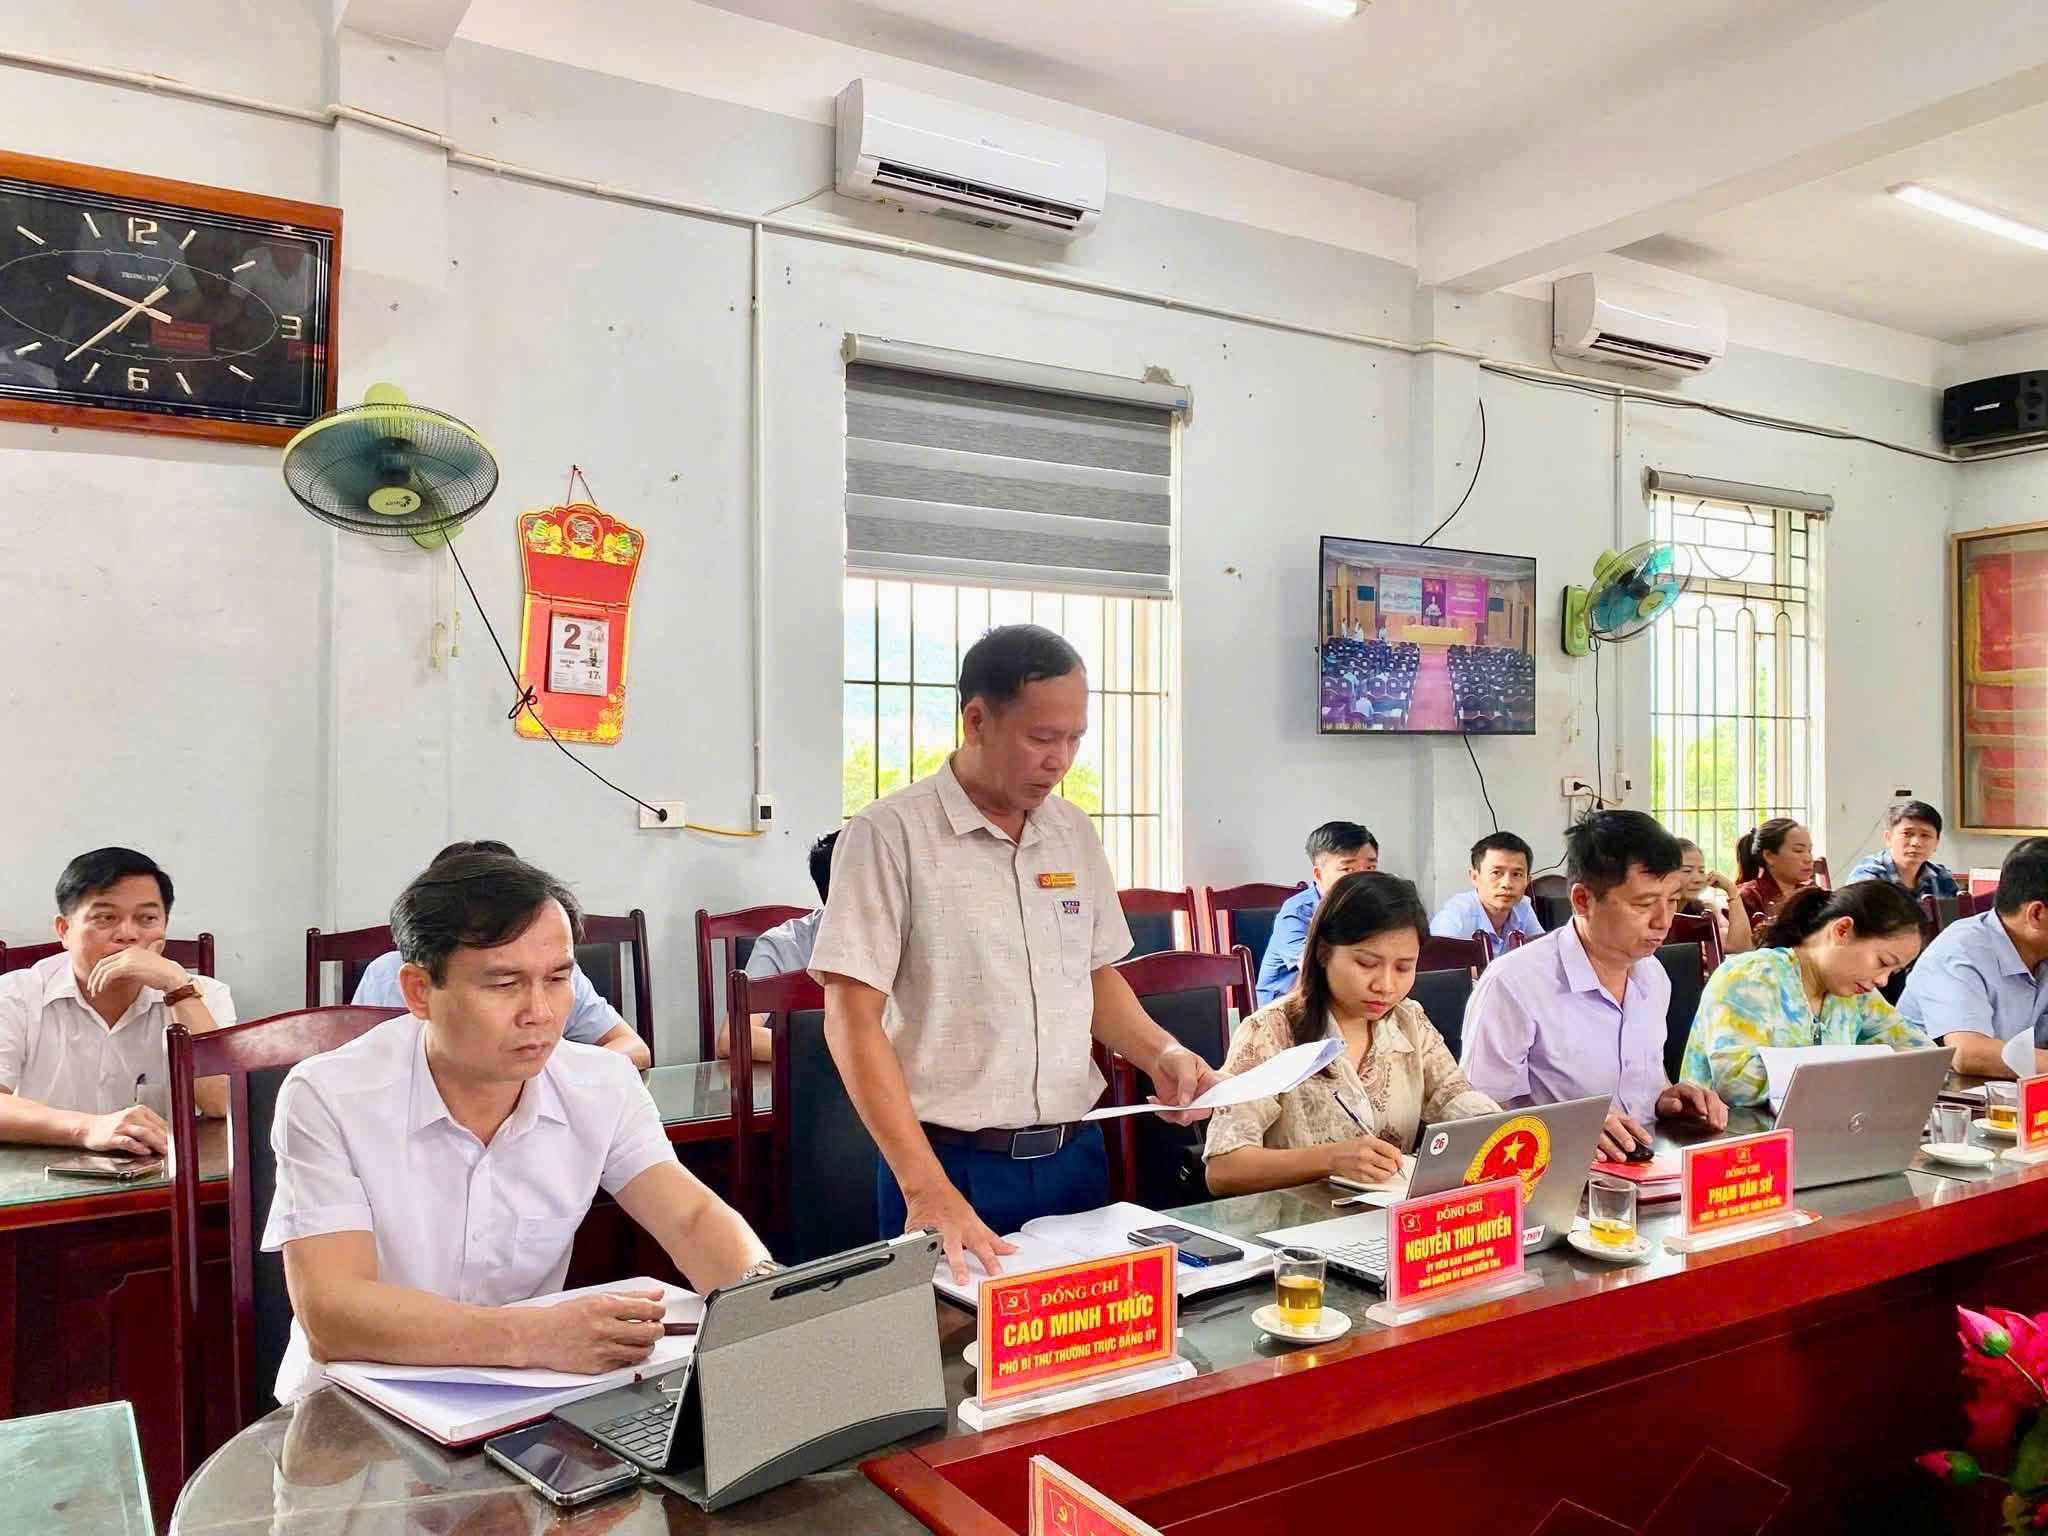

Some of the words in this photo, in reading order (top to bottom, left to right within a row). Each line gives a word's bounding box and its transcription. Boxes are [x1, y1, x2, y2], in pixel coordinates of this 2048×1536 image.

[127, 216, 158, 246] 12
[280, 314, 303, 340] 3
[127, 367, 150, 393] 6
[563, 623, 582, 650] 2
[1433, 1137, 1445, 1149] 26
[1739, 1177, 1759, 1199] VĂN
[1436, 1203, 1465, 1222] ĐỒNG
[1466, 1198, 1484, 1214] CHÍ
[1405, 1225, 1452, 1263] NGUYỄN
[1454, 1225, 1475, 1250] THU
[1040, 1284, 1087, 1307] ĐỒNG
[1090, 1275, 1119, 1296] CHÍ
[1002, 1317, 1043, 1348] CAO
[1049, 1304, 1102, 1338] MINH
[1106, 1290, 1154, 1325] THỨC
[999, 1355, 1019, 1377] PHÓ
[1021, 1352, 1032, 1371] BÍ
[1034, 1350, 1053, 1369] THƯ
